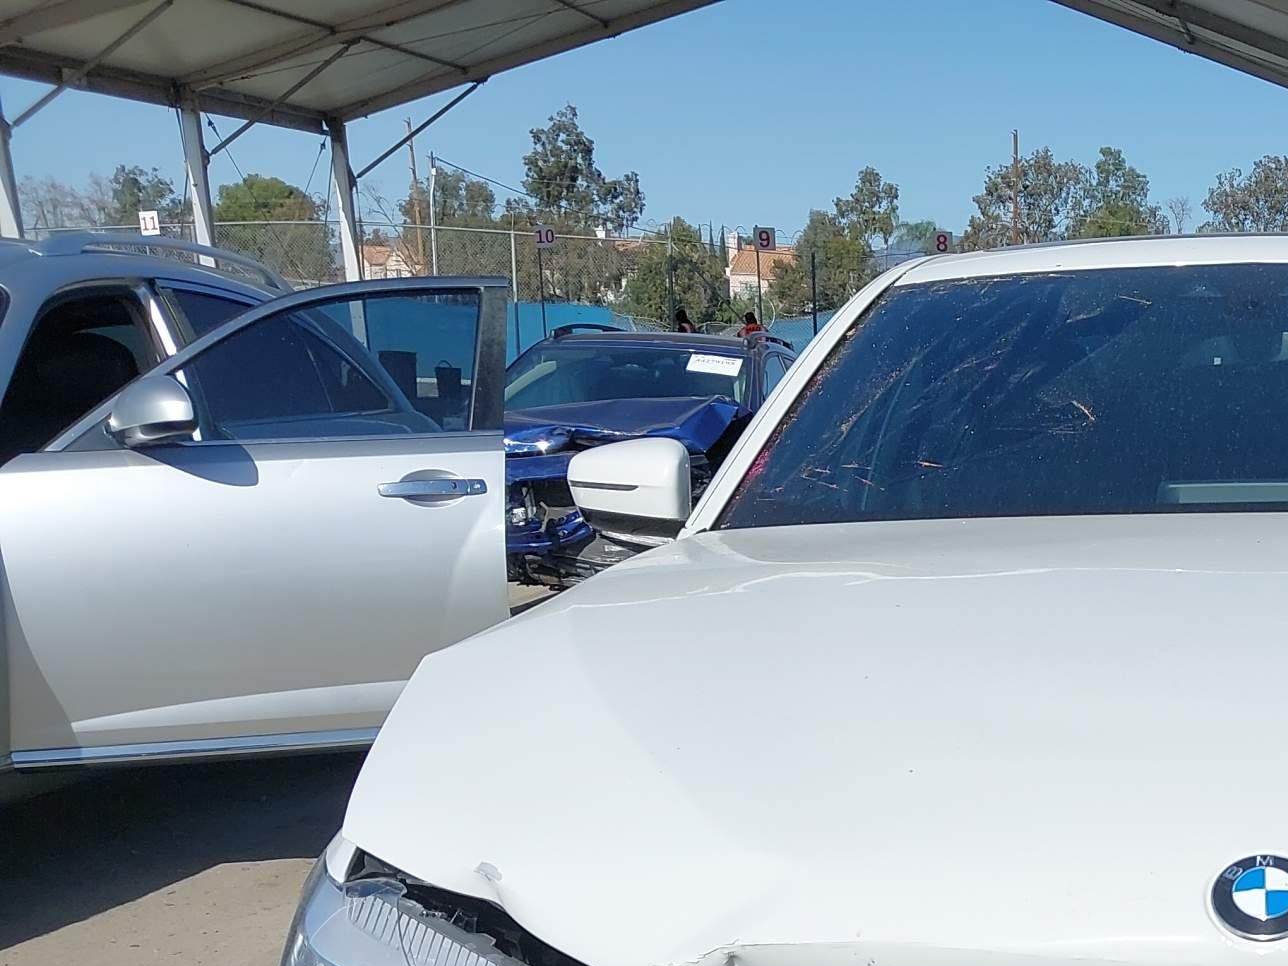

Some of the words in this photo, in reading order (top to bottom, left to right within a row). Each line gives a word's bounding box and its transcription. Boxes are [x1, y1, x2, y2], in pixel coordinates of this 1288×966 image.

[140, 216, 158, 231] 11
[535, 229, 554, 243] 10
[758, 230, 770, 248] 9
[936, 234, 948, 252] 8
